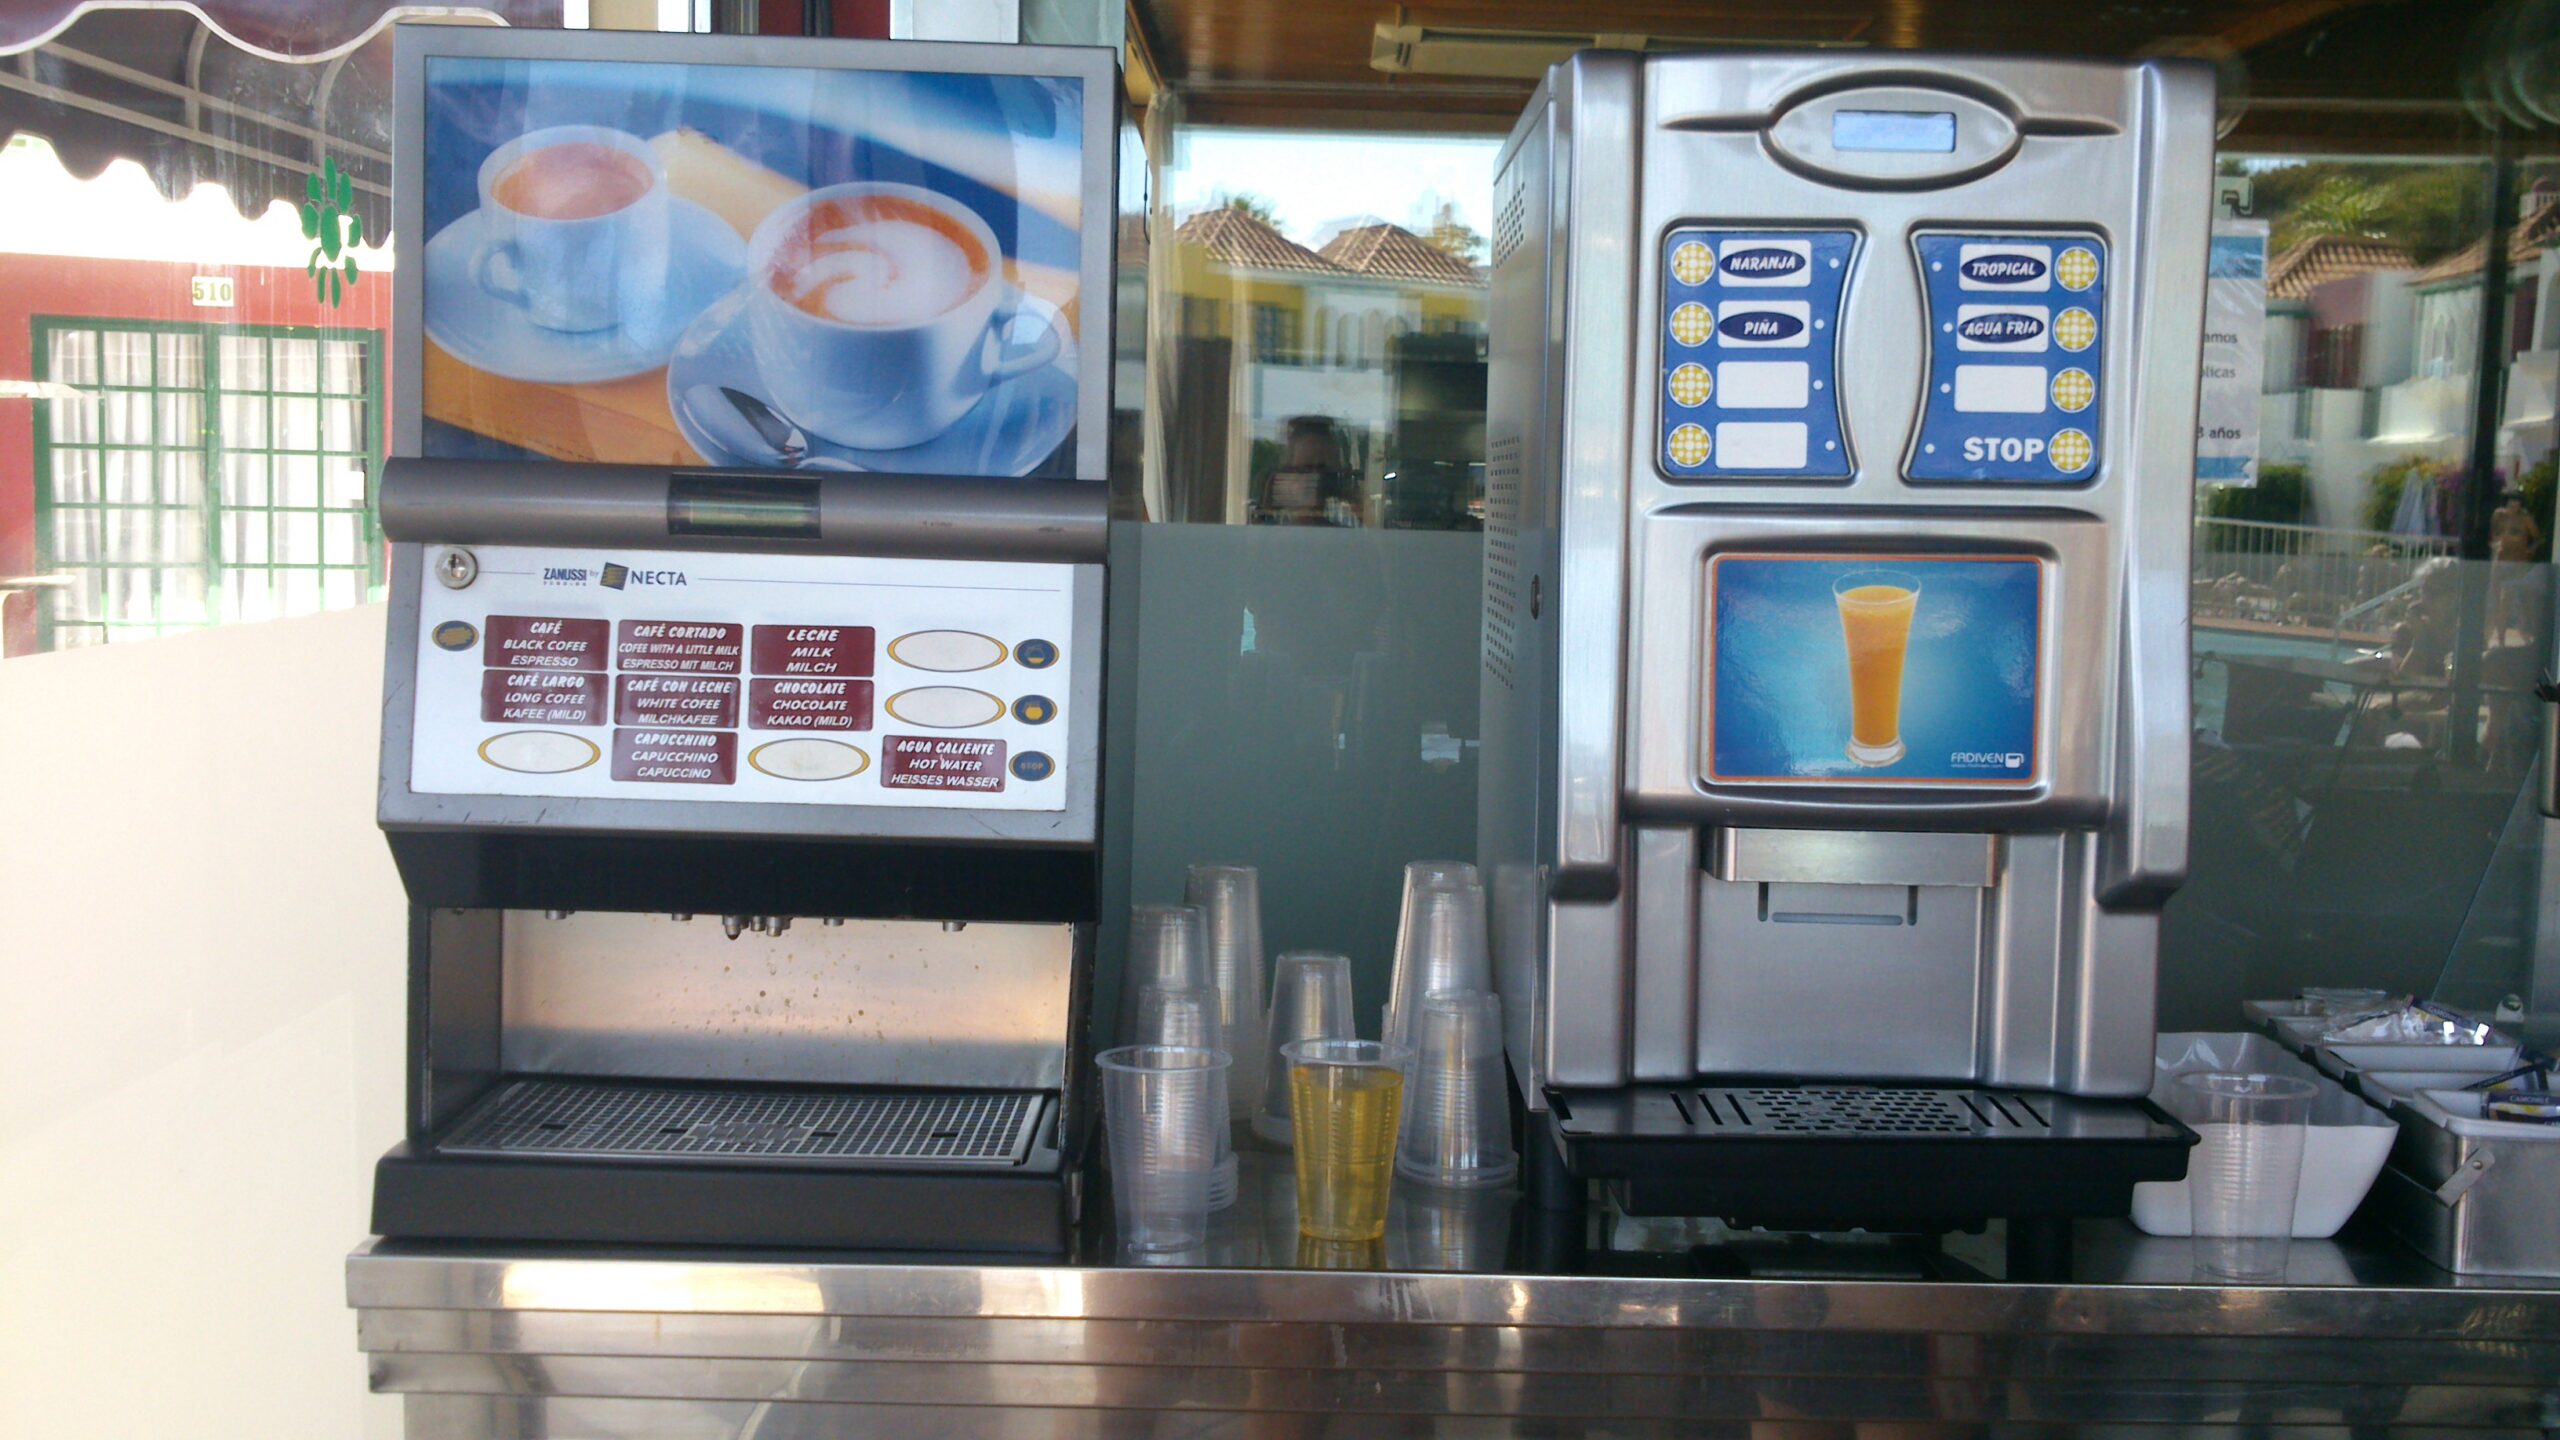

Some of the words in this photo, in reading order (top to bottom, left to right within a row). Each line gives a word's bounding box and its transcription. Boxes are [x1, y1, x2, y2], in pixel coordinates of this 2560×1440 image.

[1730, 256, 1796, 271] NARANJA
[1972, 262, 2036, 277] TROPICAL
[193, 281, 232, 302] 510
[1744, 318, 1778, 335] PIÑA
[1965, 322, 2002, 336] AGUA
[2006, 320, 2038, 335] FRIA
[2209, 427, 2241, 439] años
[1963, 436, 2045, 462] STOP
[544, 568, 587, 581] ZANUSSI
[631, 571, 687, 586] NECTA
[530, 620, 563, 634] CAFÉ
[634, 623, 666, 637] CAFÉ
[668, 626, 726, 639] CORTADO
[786, 629, 840, 642] LECHE
[503, 639, 545, 650] BLACK
[547, 640, 588, 652] COFEE
[618, 643, 648, 653] COFEE
[650, 643, 674, 654] WITH
[675, 644, 683, 654] A
[685, 644, 714, 655] LITTLE
[715, 645, 740, 656] MILK
[791, 647, 834, 657] MILK
[510, 655, 578, 667] ESPRESSO
[622, 658, 679, 670] ESPRESSO
[680, 660, 699, 670] MIT
[700, 661, 734, 671] MILCH
[785, 662, 838, 673] MILCH
[507, 674, 539, 687] CAFÉ
[541, 676, 585, 688] LARGO
[627, 677, 659, 691] CAFÉ
[662, 680, 688, 693] CON
[691, 681, 732, 694] LECHE
[774, 682, 847, 695] CHOCOLATE
[504, 692, 542, 704] LONG
[545, 693, 586, 704] COFEE
[636, 698, 678, 709] WHITE
[680, 699, 722, 710] COFEE
[772, 699, 848, 711] CHOCOLATE
[503, 708, 545, 719] KAFEE
[547, 709, 587, 721] (MILD)
[638, 713, 719, 725] MILCHKAFEE
[766, 715, 812, 726] KAKAO
[813, 716, 853, 728] (MILD)
[634, 733, 717, 747] CAPUCCHINO
[897, 740, 932, 754] AGUA
[935, 742, 995, 755] CALIENTE
[631, 750, 719, 763] CAPUCCHINO
[1951, 752, 2004, 763] FADIVEN
[909, 759, 938, 769] HOT
[940, 760, 983, 771] WATER
[636, 766, 712, 779] CAPUCCINO
[891, 774, 944, 785] HEISSES
[946, 775, 999, 788] WASSER
